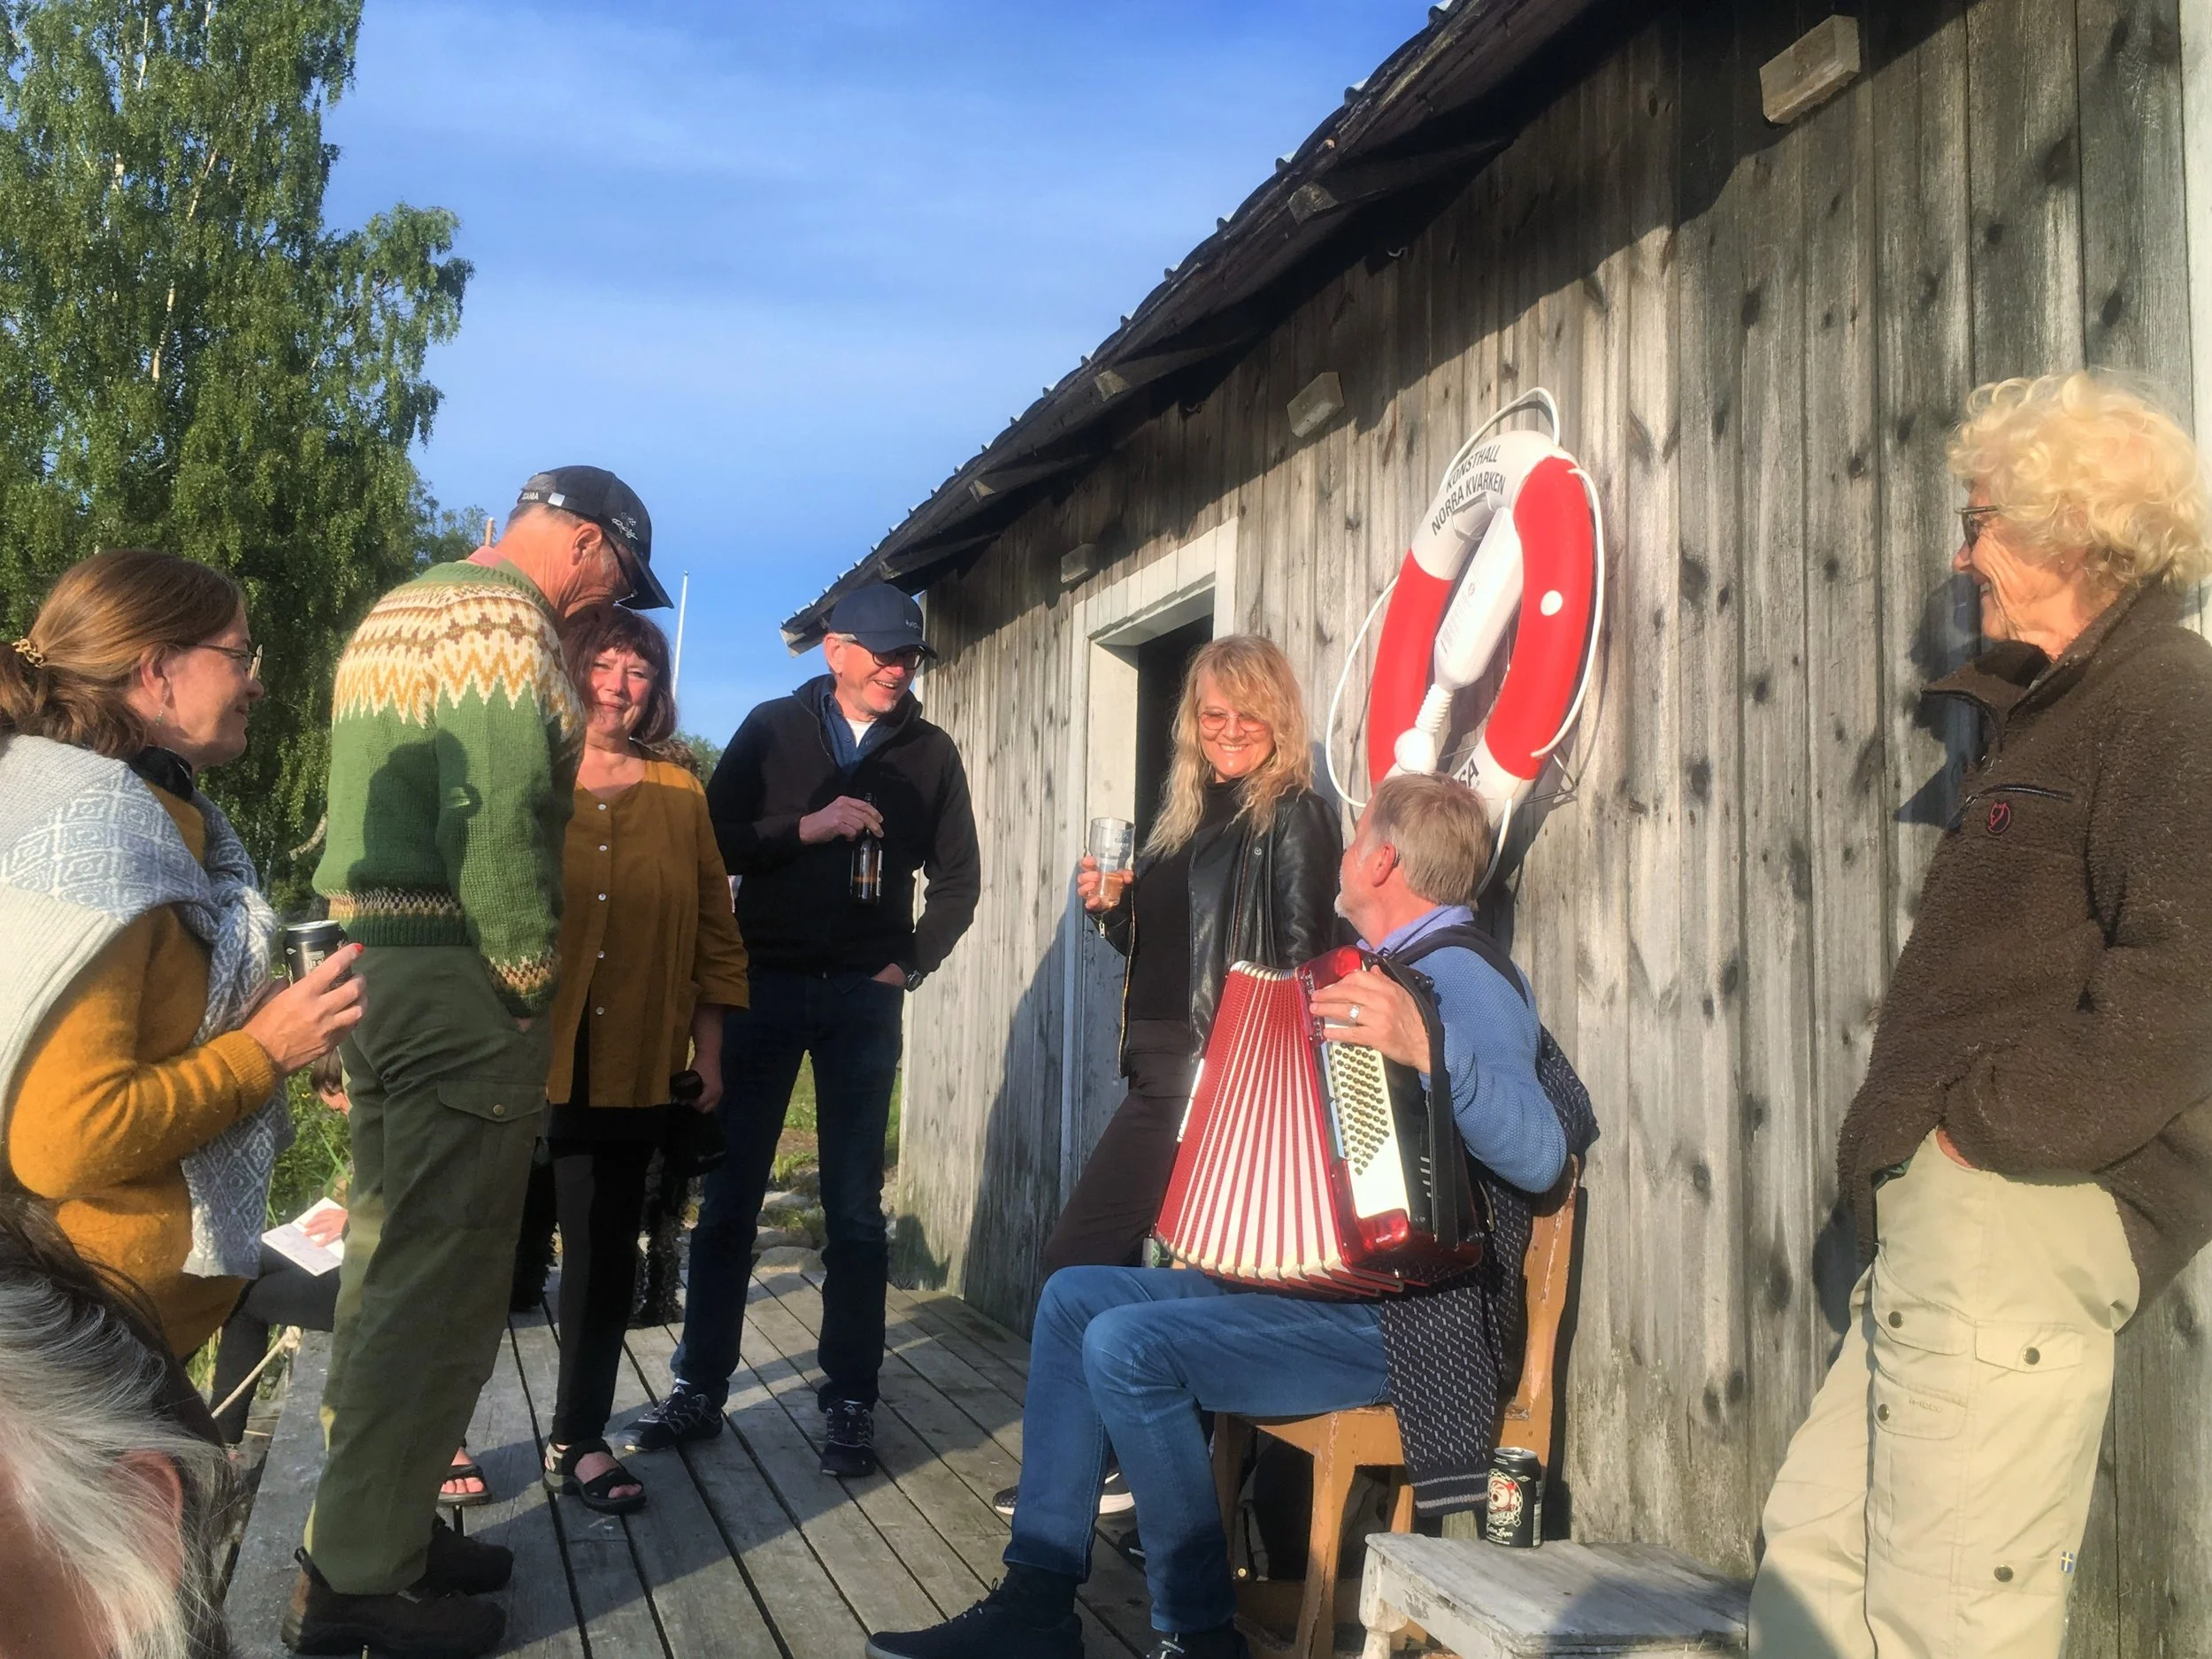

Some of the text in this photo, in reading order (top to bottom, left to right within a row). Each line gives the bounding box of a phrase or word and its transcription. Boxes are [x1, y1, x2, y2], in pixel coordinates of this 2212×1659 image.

[1446, 445, 1501, 494] KONSTHALL
[1431, 471, 1507, 536] NORRA KVARKEN
[1458, 757, 1479, 788] SA
